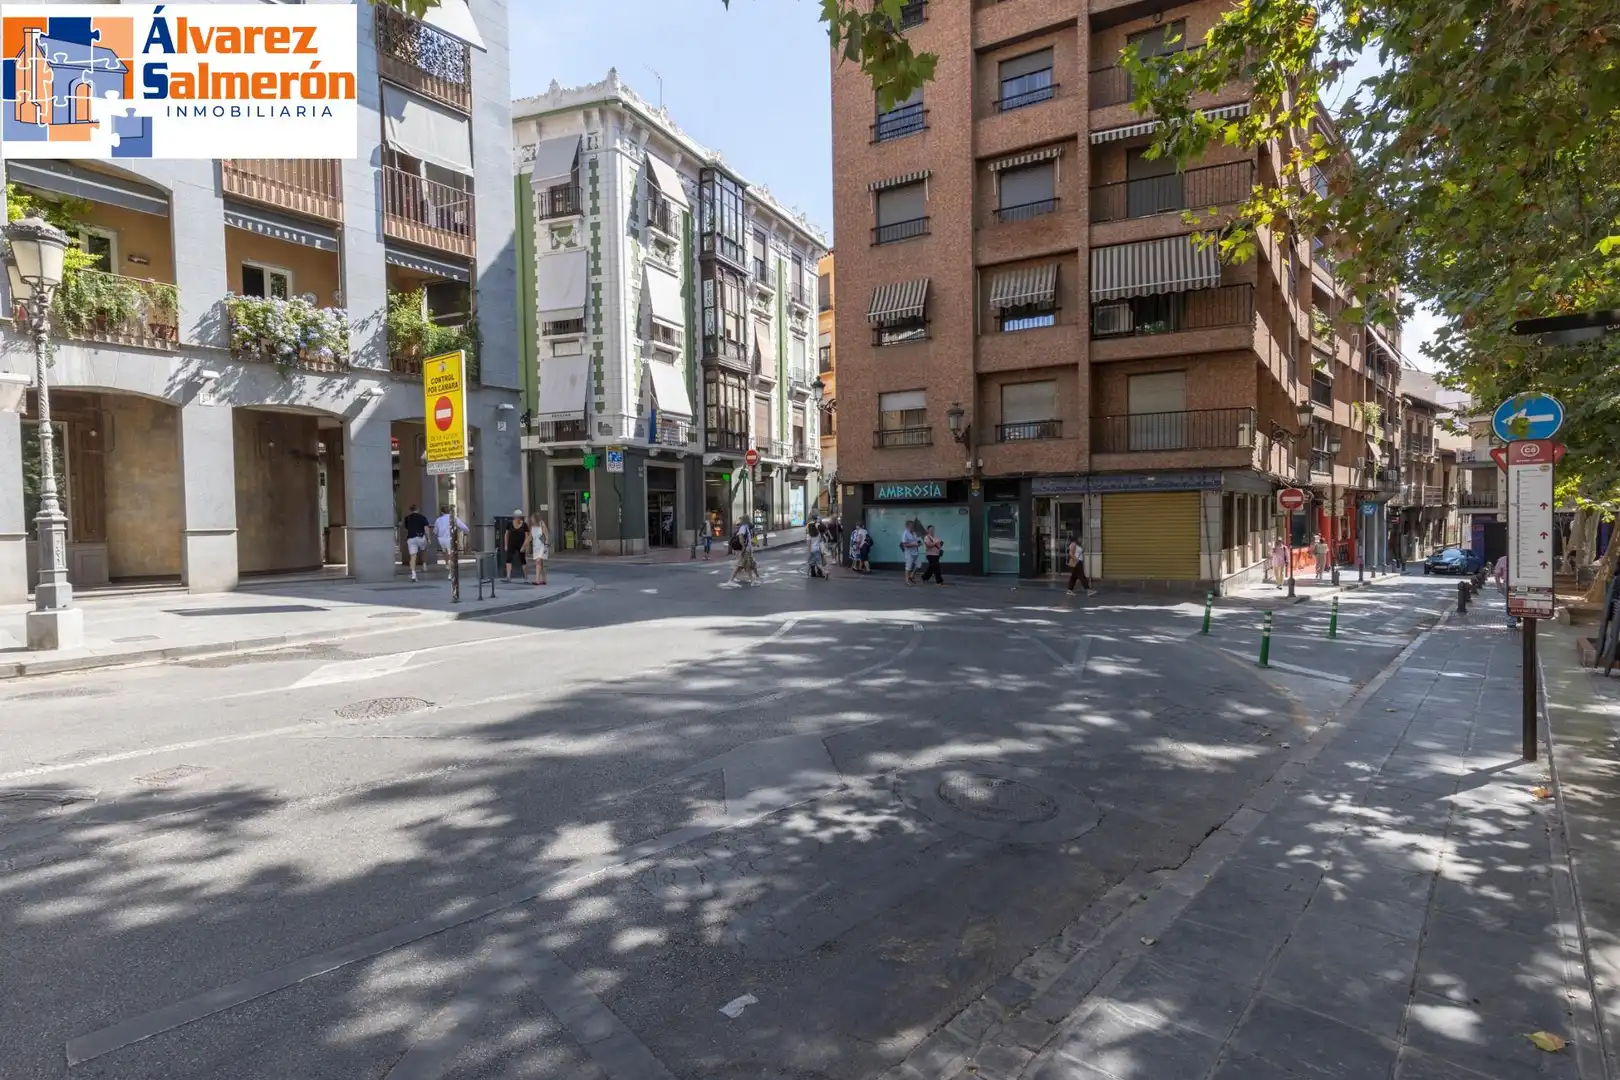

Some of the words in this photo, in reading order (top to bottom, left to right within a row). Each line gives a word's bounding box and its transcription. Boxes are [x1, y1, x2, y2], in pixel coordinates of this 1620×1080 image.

[430, 374, 455, 385] CONTROL
[428, 385, 437, 393] POR
[878, 481, 942, 498] AMBROSÍA
